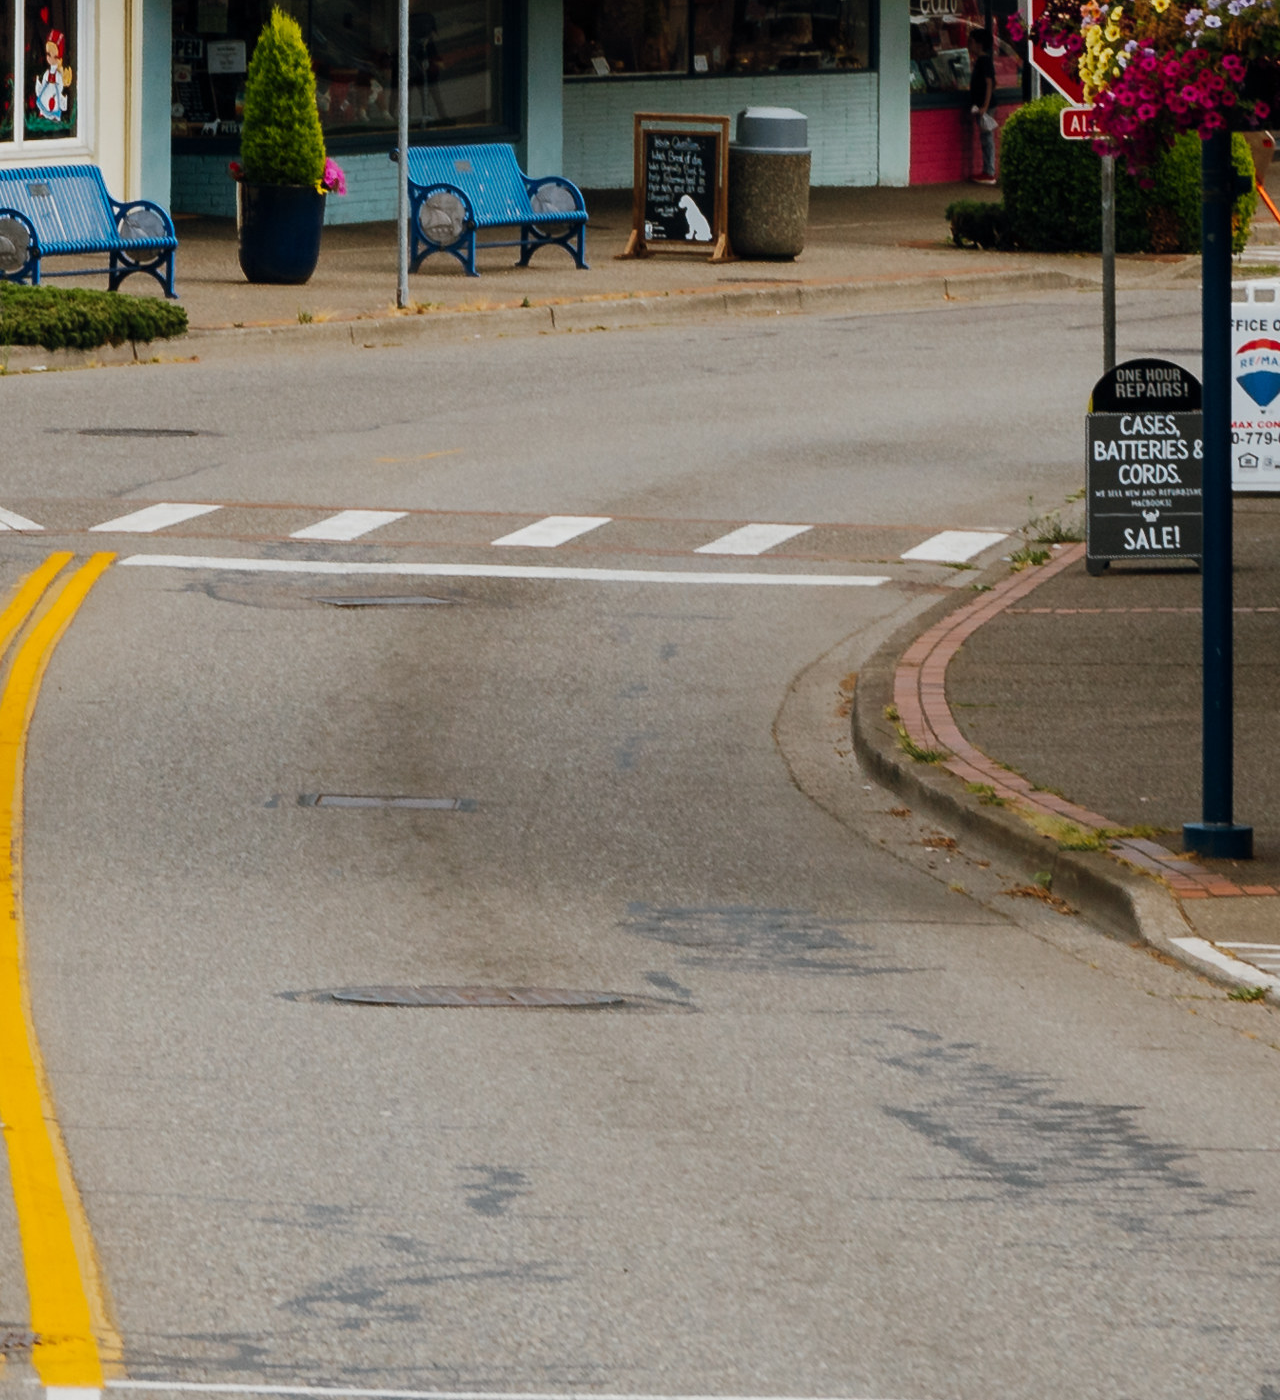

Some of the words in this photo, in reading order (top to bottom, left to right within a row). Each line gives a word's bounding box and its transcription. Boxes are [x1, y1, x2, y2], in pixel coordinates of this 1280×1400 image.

[1116, 368, 1142, 383] ONE
[1146, 368, 1181, 383] HOUR
[1116, 382, 1189, 399] REPAIRS!
[1120, 414, 1181, 438] CASES,
[1094, 439, 1189, 461] BATTERIES
[1193, 439, 1203, 460] &
[1118, 463, 1182, 485] CORDS.
[1095, 490, 1105, 498] WE
[1107, 489, 1123, 498] SELL
[1125, 489, 1140, 498] NEW
[1142, 488, 1157, 497] AND
[1124, 526, 1181, 550] SALE!
